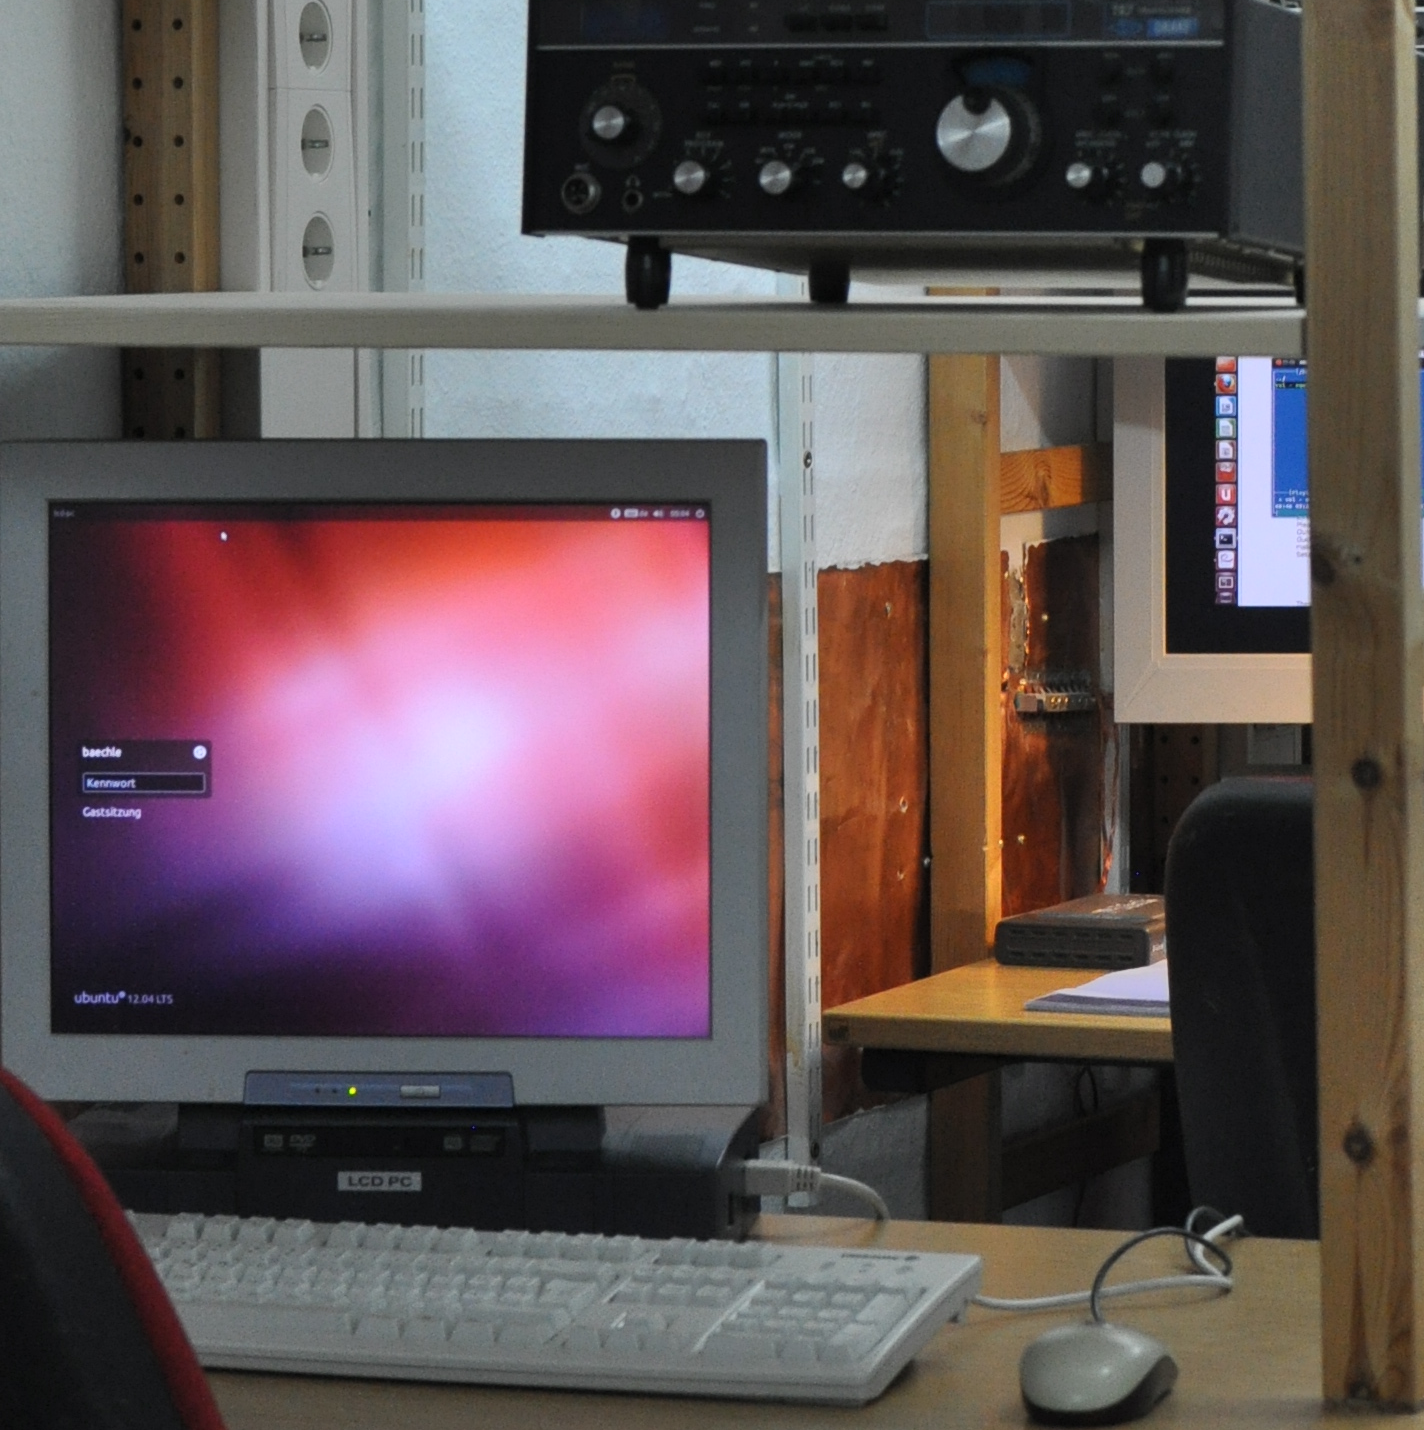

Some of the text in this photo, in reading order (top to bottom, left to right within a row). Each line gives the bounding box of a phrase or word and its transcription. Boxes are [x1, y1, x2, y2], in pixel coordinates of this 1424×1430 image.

[82, 746, 122, 758] baechle
[87, 778, 136, 789] Kennwort
[82, 806, 142, 819] Gastsitzung
[74, 991, 174, 1004] ubuntu 12.04 LTS
[347, 1176, 412, 1187] LCD PC
